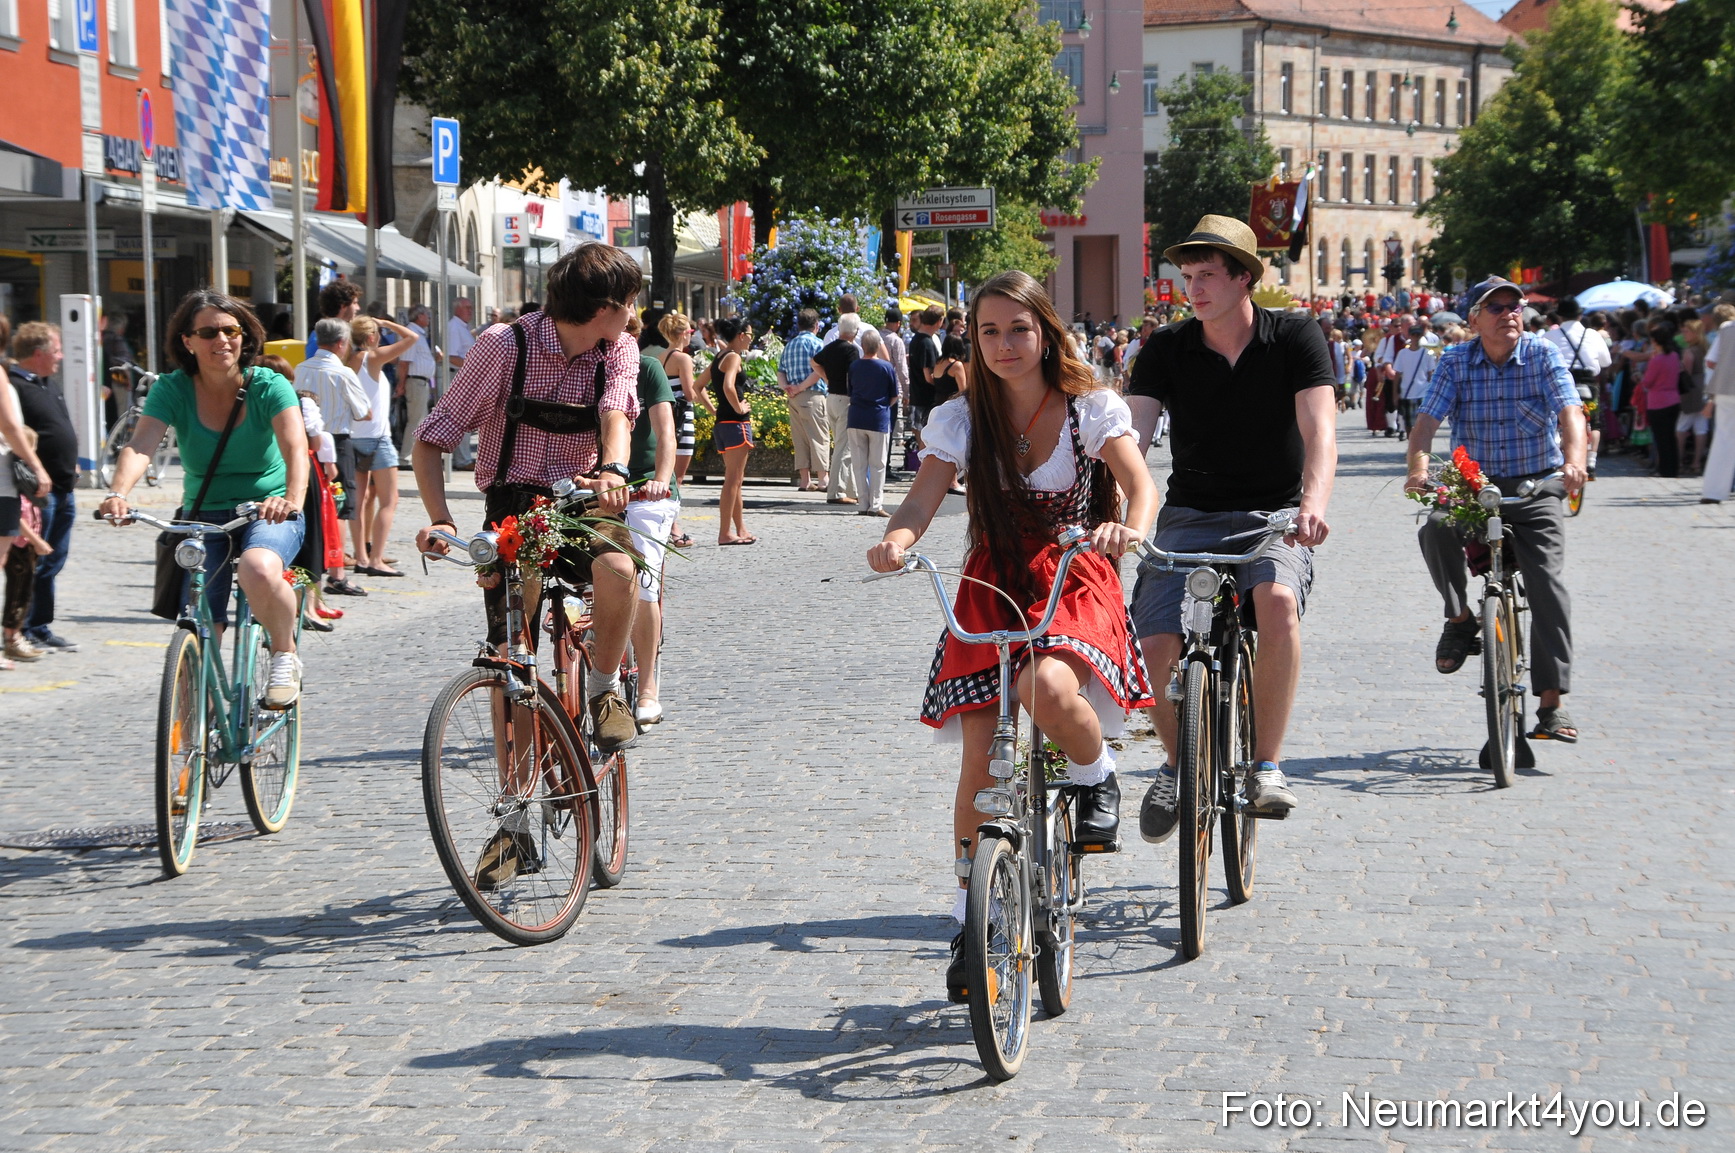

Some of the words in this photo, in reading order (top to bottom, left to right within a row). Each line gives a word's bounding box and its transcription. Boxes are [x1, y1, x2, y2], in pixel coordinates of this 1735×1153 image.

[103, 133, 181, 180] ABAKAREN
[438, 127, 454, 175] P
[912, 193, 976, 205] Parkleitsystem
[935, 213, 977, 224] Rosengasse
[1040, 211, 1088, 227] kasse
[30, 234, 57, 247] NZ
[913, 246, 941, 254] Rosengasse
